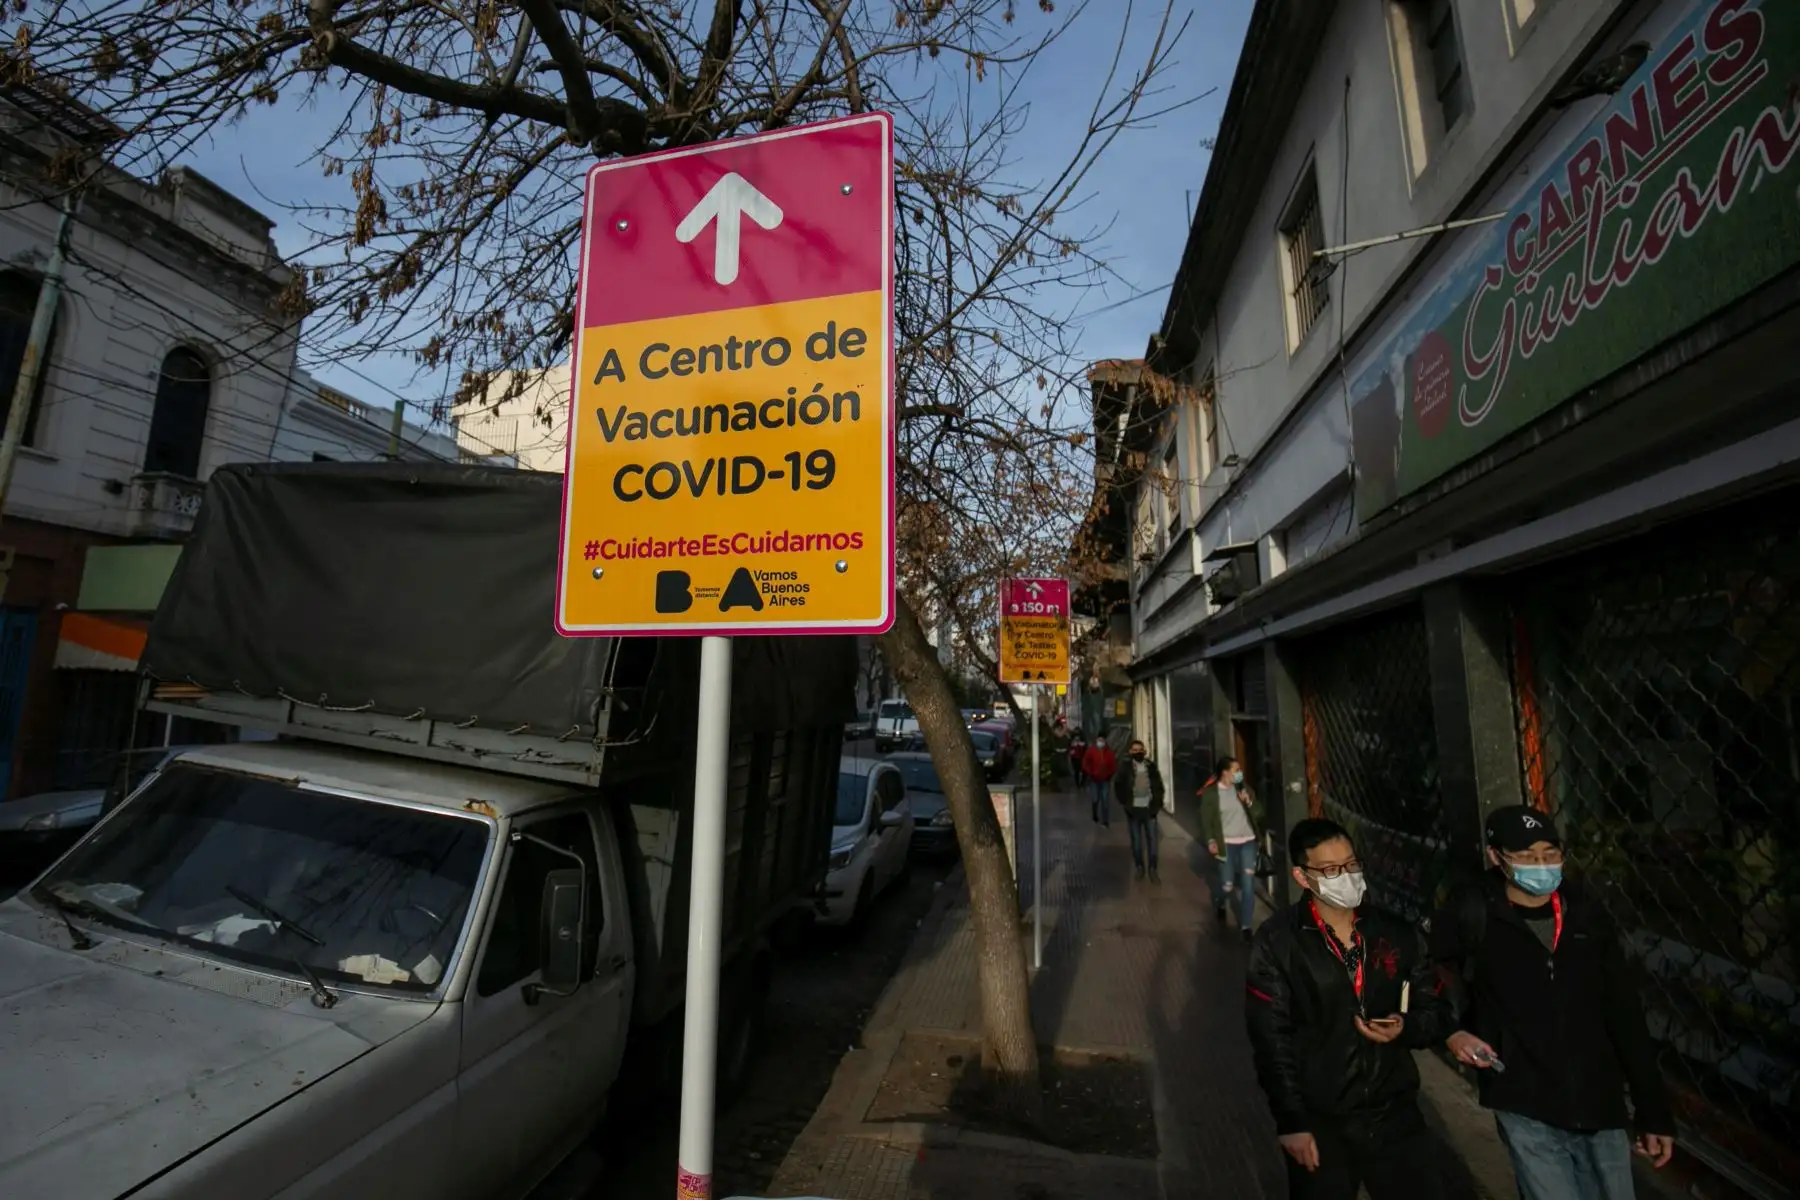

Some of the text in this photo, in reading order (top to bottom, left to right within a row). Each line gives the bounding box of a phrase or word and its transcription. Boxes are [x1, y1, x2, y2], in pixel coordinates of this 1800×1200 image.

[1505, 0, 1766, 278] CARNES
[593, 320, 868, 386] A Centro de
[596, 382, 861, 443] Vacunación
[613, 449, 836, 502] COVID-19
[583, 530, 864, 562] #CuidarteEsCuidarnos
[655, 566, 764, 614] B A
[754, 570, 797, 581] Vamos
[761, 582, 810, 594] Buenos
[769, 595, 806, 606] Aires
[1023, 602, 1044, 613] 150
[1015, 651, 1057, 660] COVID-19
